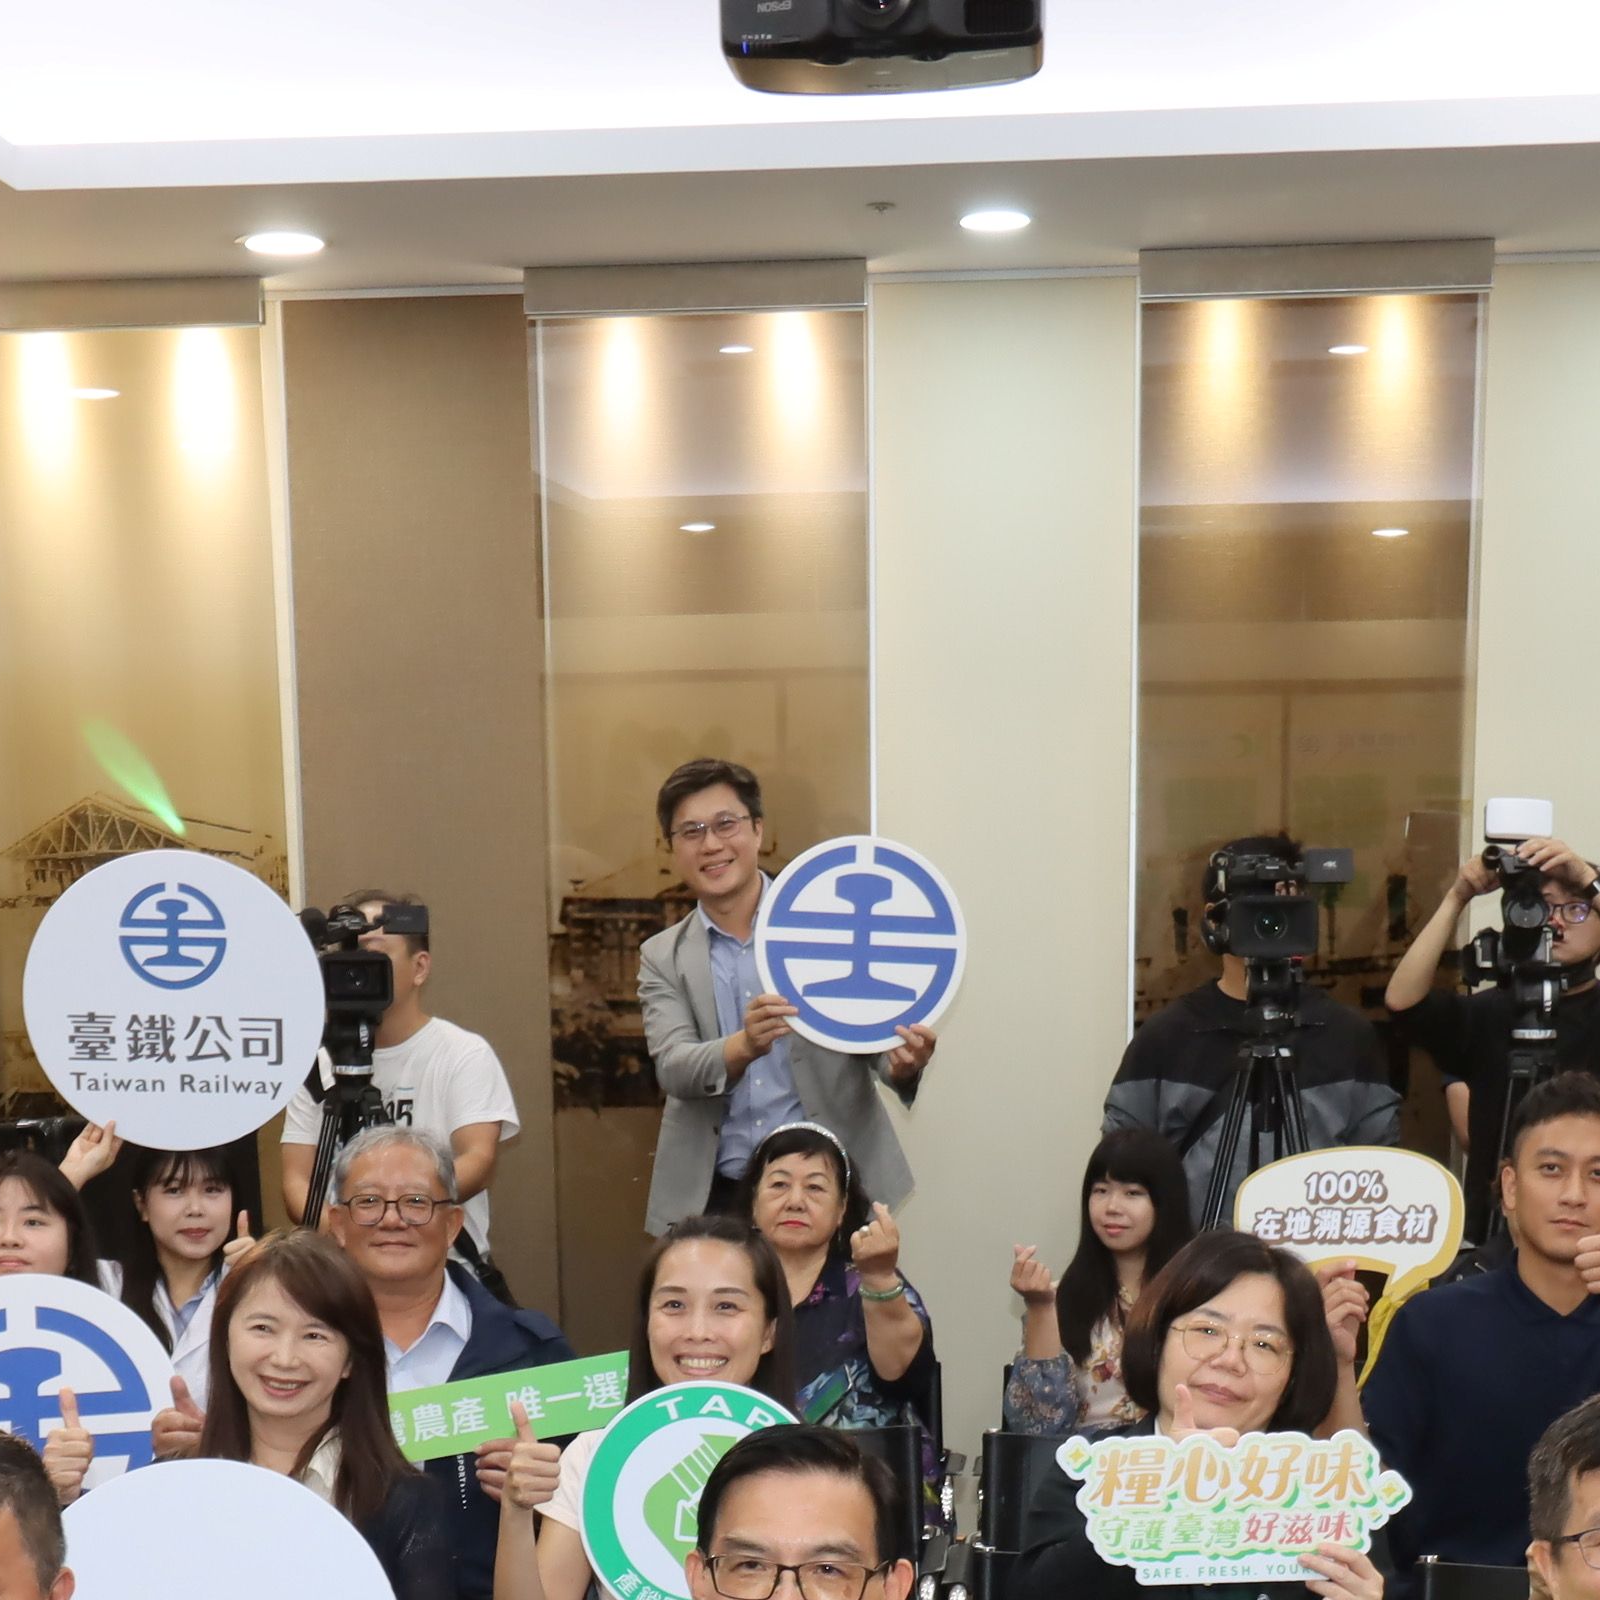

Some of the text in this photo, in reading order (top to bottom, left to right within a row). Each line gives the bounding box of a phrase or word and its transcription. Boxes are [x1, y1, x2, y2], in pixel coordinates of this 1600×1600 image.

[757, 0, 792, 13] EPSON
[67, 1012, 283, 1066] 臺鐵公司
[70, 1072, 283, 1101] Taiwan Railway
[1305, 1170, 1388, 1205] 100%
[1254, 1205, 1438, 1245] 在地溯源食材
[505, 1366, 629, 1421] 唯一選
[1089, 1442, 1367, 1508] 糧心好味
[1099, 1511, 1354, 1551] 守護臺灣好滋味
[1143, 1567, 1190, 1579] SAFE.
[1198, 1564, 1258, 1578] FRESH.
